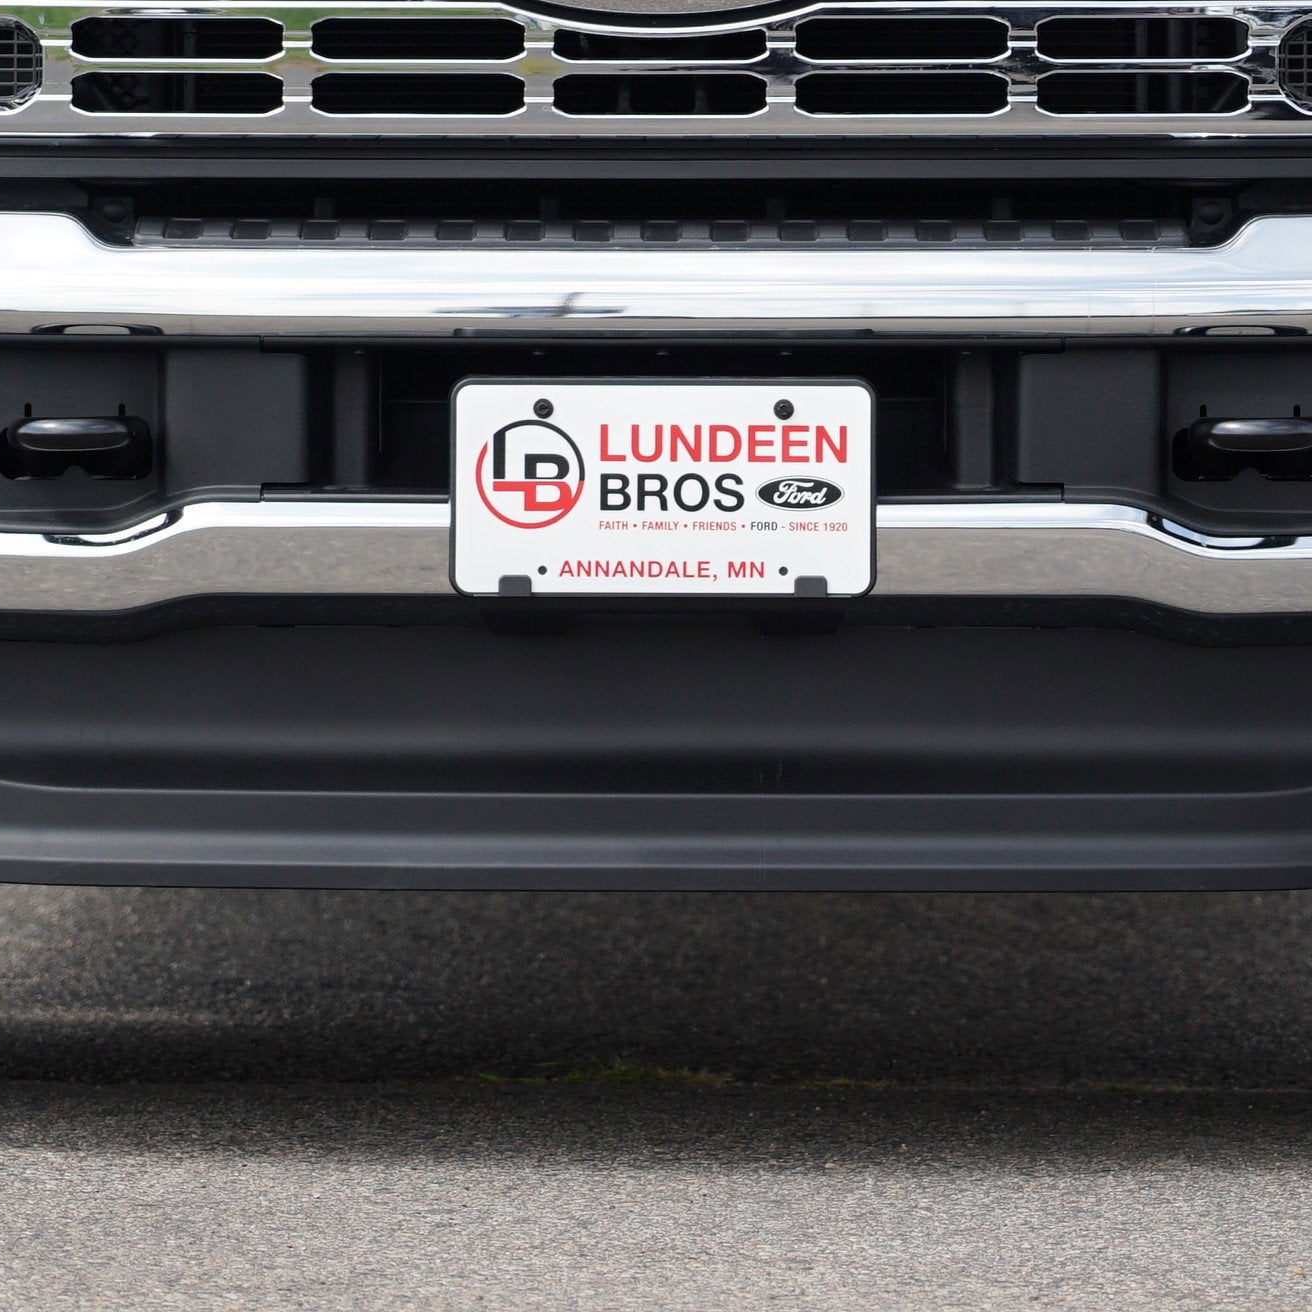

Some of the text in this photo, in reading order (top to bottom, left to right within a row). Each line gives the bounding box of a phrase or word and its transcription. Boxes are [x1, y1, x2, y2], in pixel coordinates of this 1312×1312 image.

[600, 424, 847, 463] LUNDEEN
[600, 473, 745, 512] BROS
[773, 479, 827, 505] Ford
[598, 520, 848, 532] FAITH FAMILY FRIENDS FORD SINCE 1920
[559, 560, 764, 581] ANNANDALE, MN
